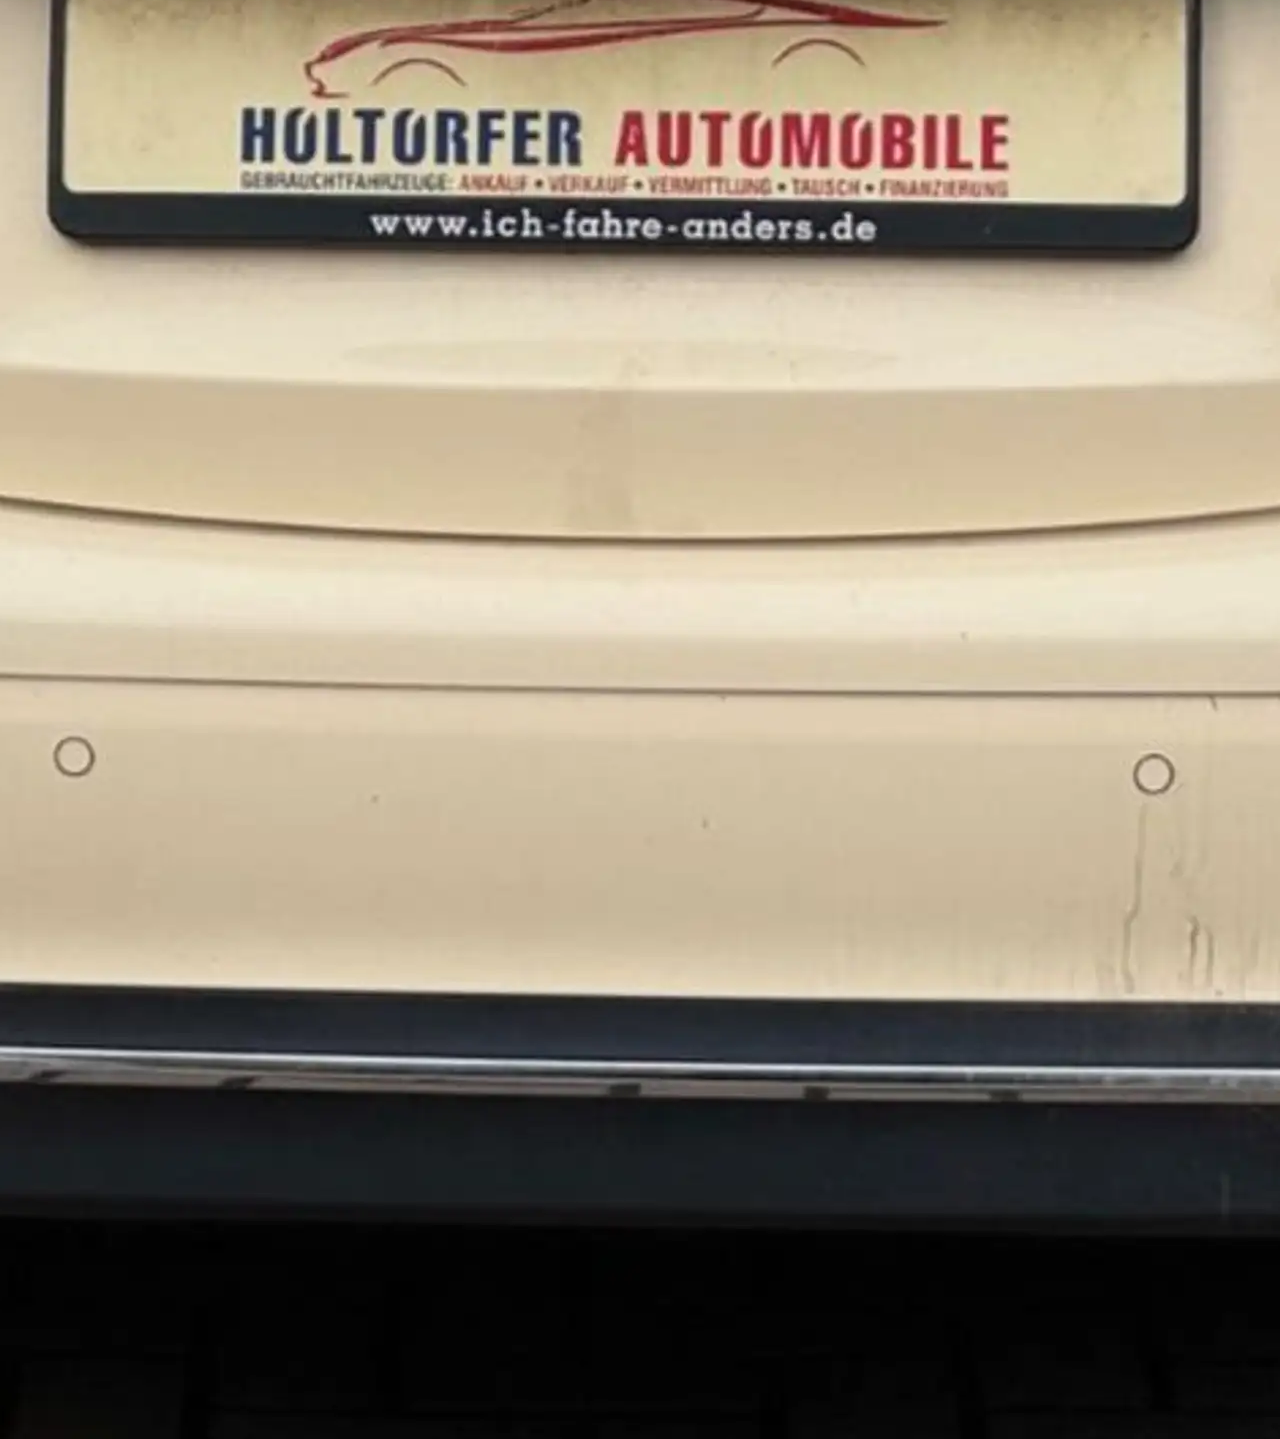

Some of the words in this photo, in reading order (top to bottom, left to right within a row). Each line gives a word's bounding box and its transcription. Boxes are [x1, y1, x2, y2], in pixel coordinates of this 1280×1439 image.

[240, 105, 583, 167] HOLTORFER
[614, 110, 1010, 171] AUTOMOBILE
[239, 171, 453, 192] GEBRAUCHTFAHRZEUGE:
[458, 174, 527, 193] ANKAUF
[549, 174, 629, 194] VERKAUF
[648, 175, 773, 196] VERMITTLUNG
[790, 177, 861, 197] TAUSCH
[878, 178, 1009, 199] FINANZIERUNG
[369, 206, 878, 242] www.ich-fahre-anders.de
